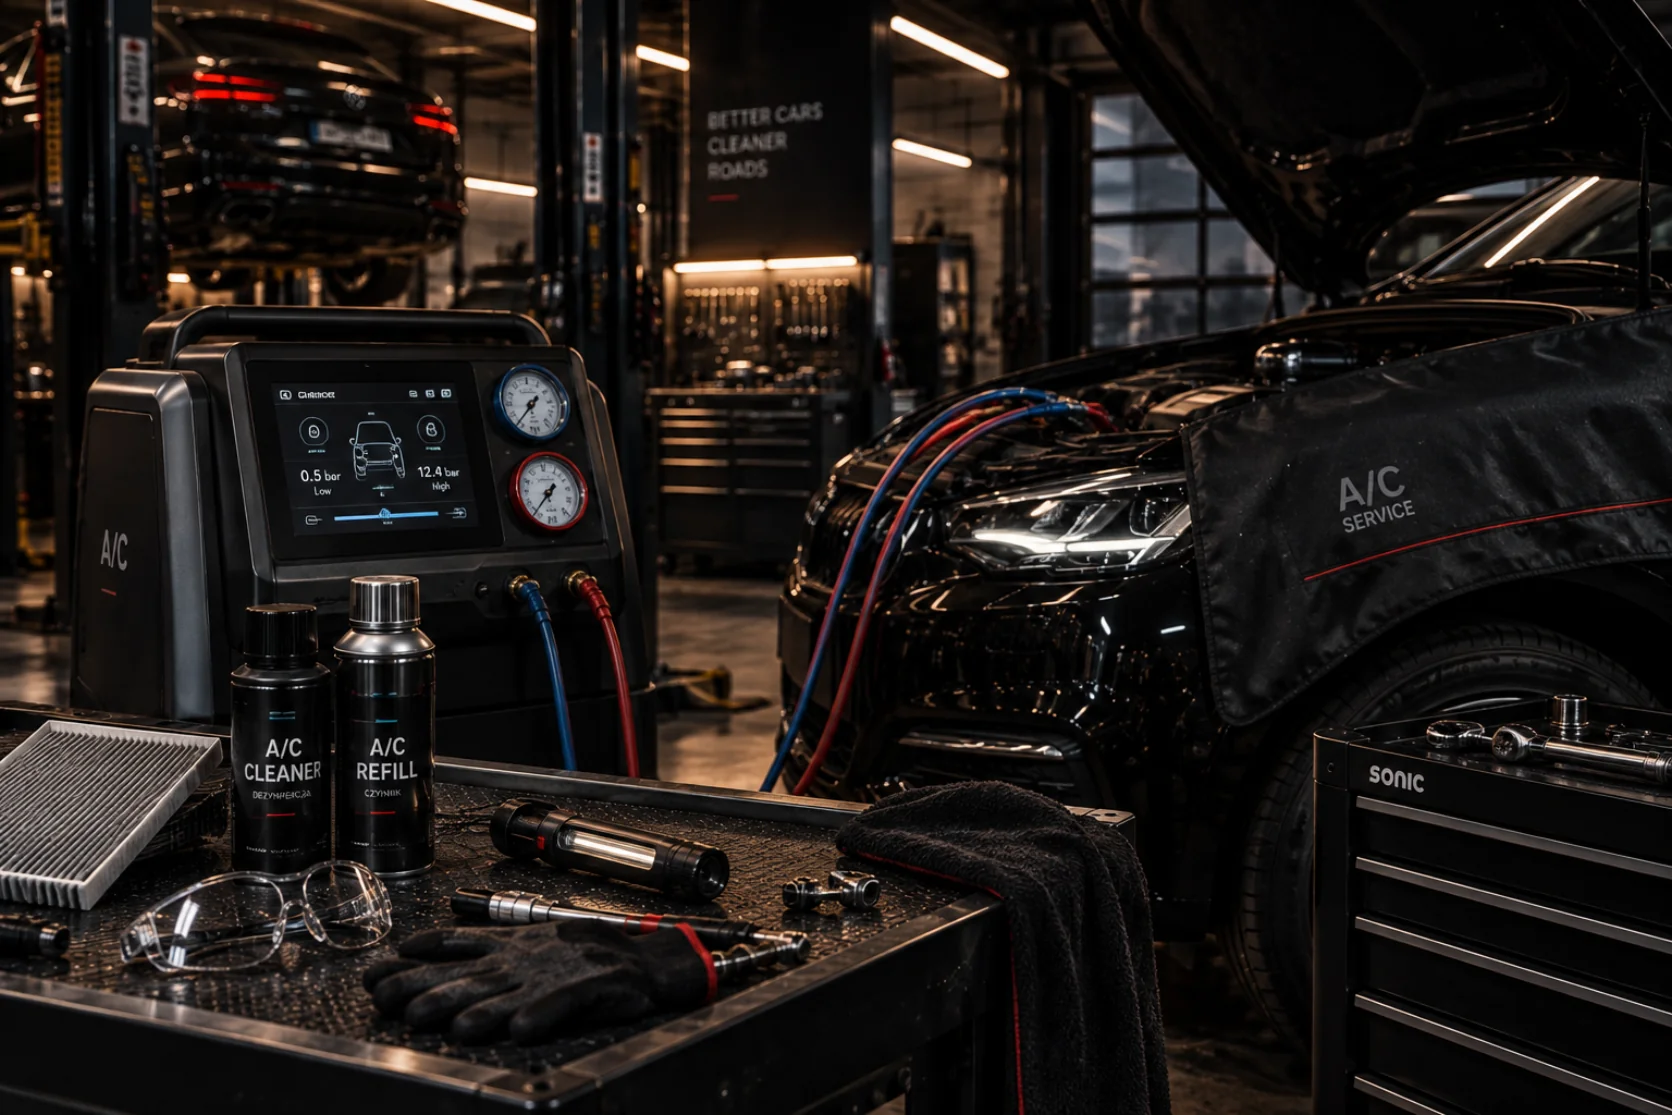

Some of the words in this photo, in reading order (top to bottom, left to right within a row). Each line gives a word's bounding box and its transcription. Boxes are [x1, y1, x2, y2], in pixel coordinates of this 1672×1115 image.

[708, 107, 771, 130] BETTER
[775, 101, 823, 123] CARS
[707, 131, 788, 155] CLEANER
[708, 159, 768, 180] ROADS
[300, 469, 321, 482] 0.5
[324, 469, 341, 481] bar
[418, 466, 442, 478] 12.4
[314, 486, 331, 496] Low
[432, 481, 451, 492] High
[1340, 465, 1405, 512] A/C
[1342, 500, 1416, 533] SERVICE
[100, 528, 129, 571] A/C
[265, 738, 302, 759] A/C
[369, 737, 405, 757] A/C
[244, 761, 321, 783] CLEANER
[356, 761, 418, 780] REFILL
[1369, 765, 1425, 793] SONIC
